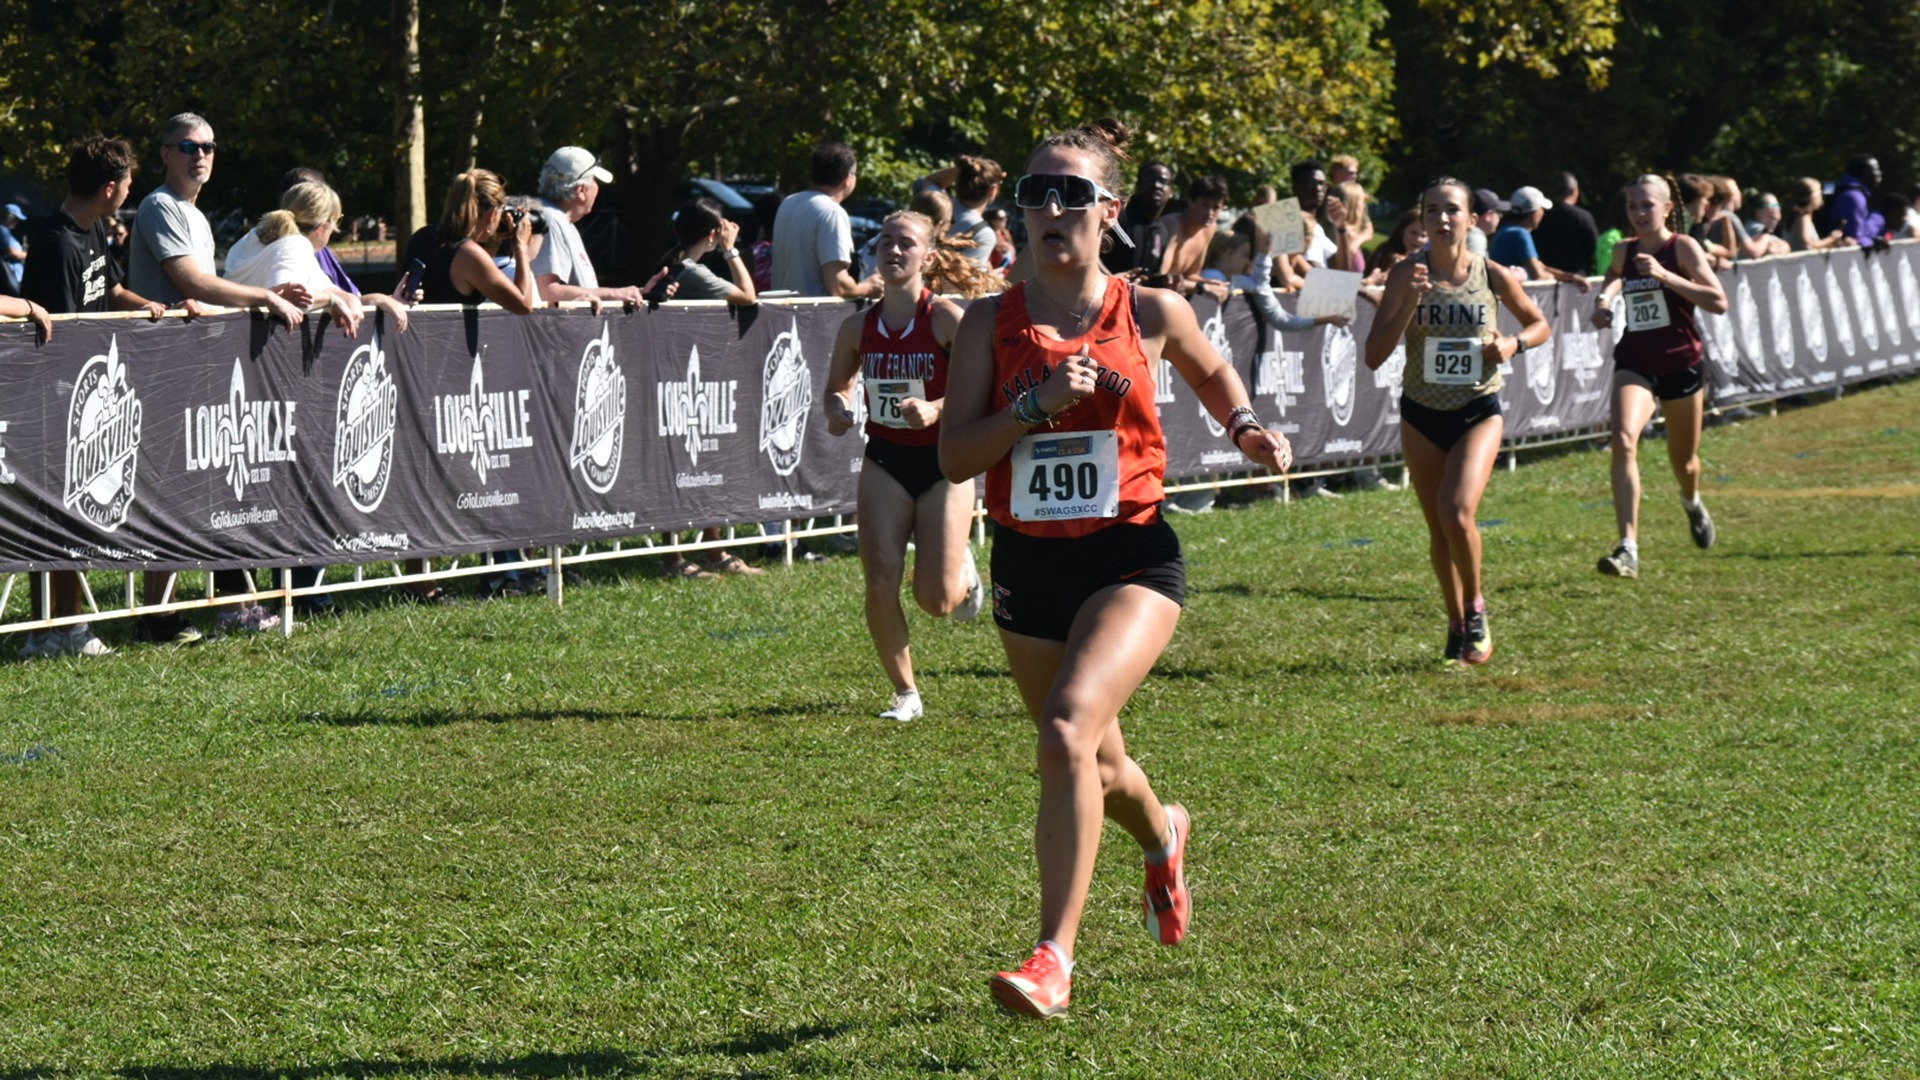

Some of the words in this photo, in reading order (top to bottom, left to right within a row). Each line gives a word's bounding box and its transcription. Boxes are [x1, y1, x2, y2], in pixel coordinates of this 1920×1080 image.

[1417, 304, 1486, 325] TRINE
[1633, 303, 1661, 322] 202
[886, 353, 935, 381] FRANCIS
[1435, 354, 1472, 374] 929
[1002, 364, 1132, 401] KALAZOO
[73, 369, 98, 427] SPORTS
[878, 395, 913, 418] 78
[1028, 462, 1098, 501] 490
[211, 507, 278, 530] GoToLouisville.com
[1034, 504, 1098, 516] #SWAGSXCC
